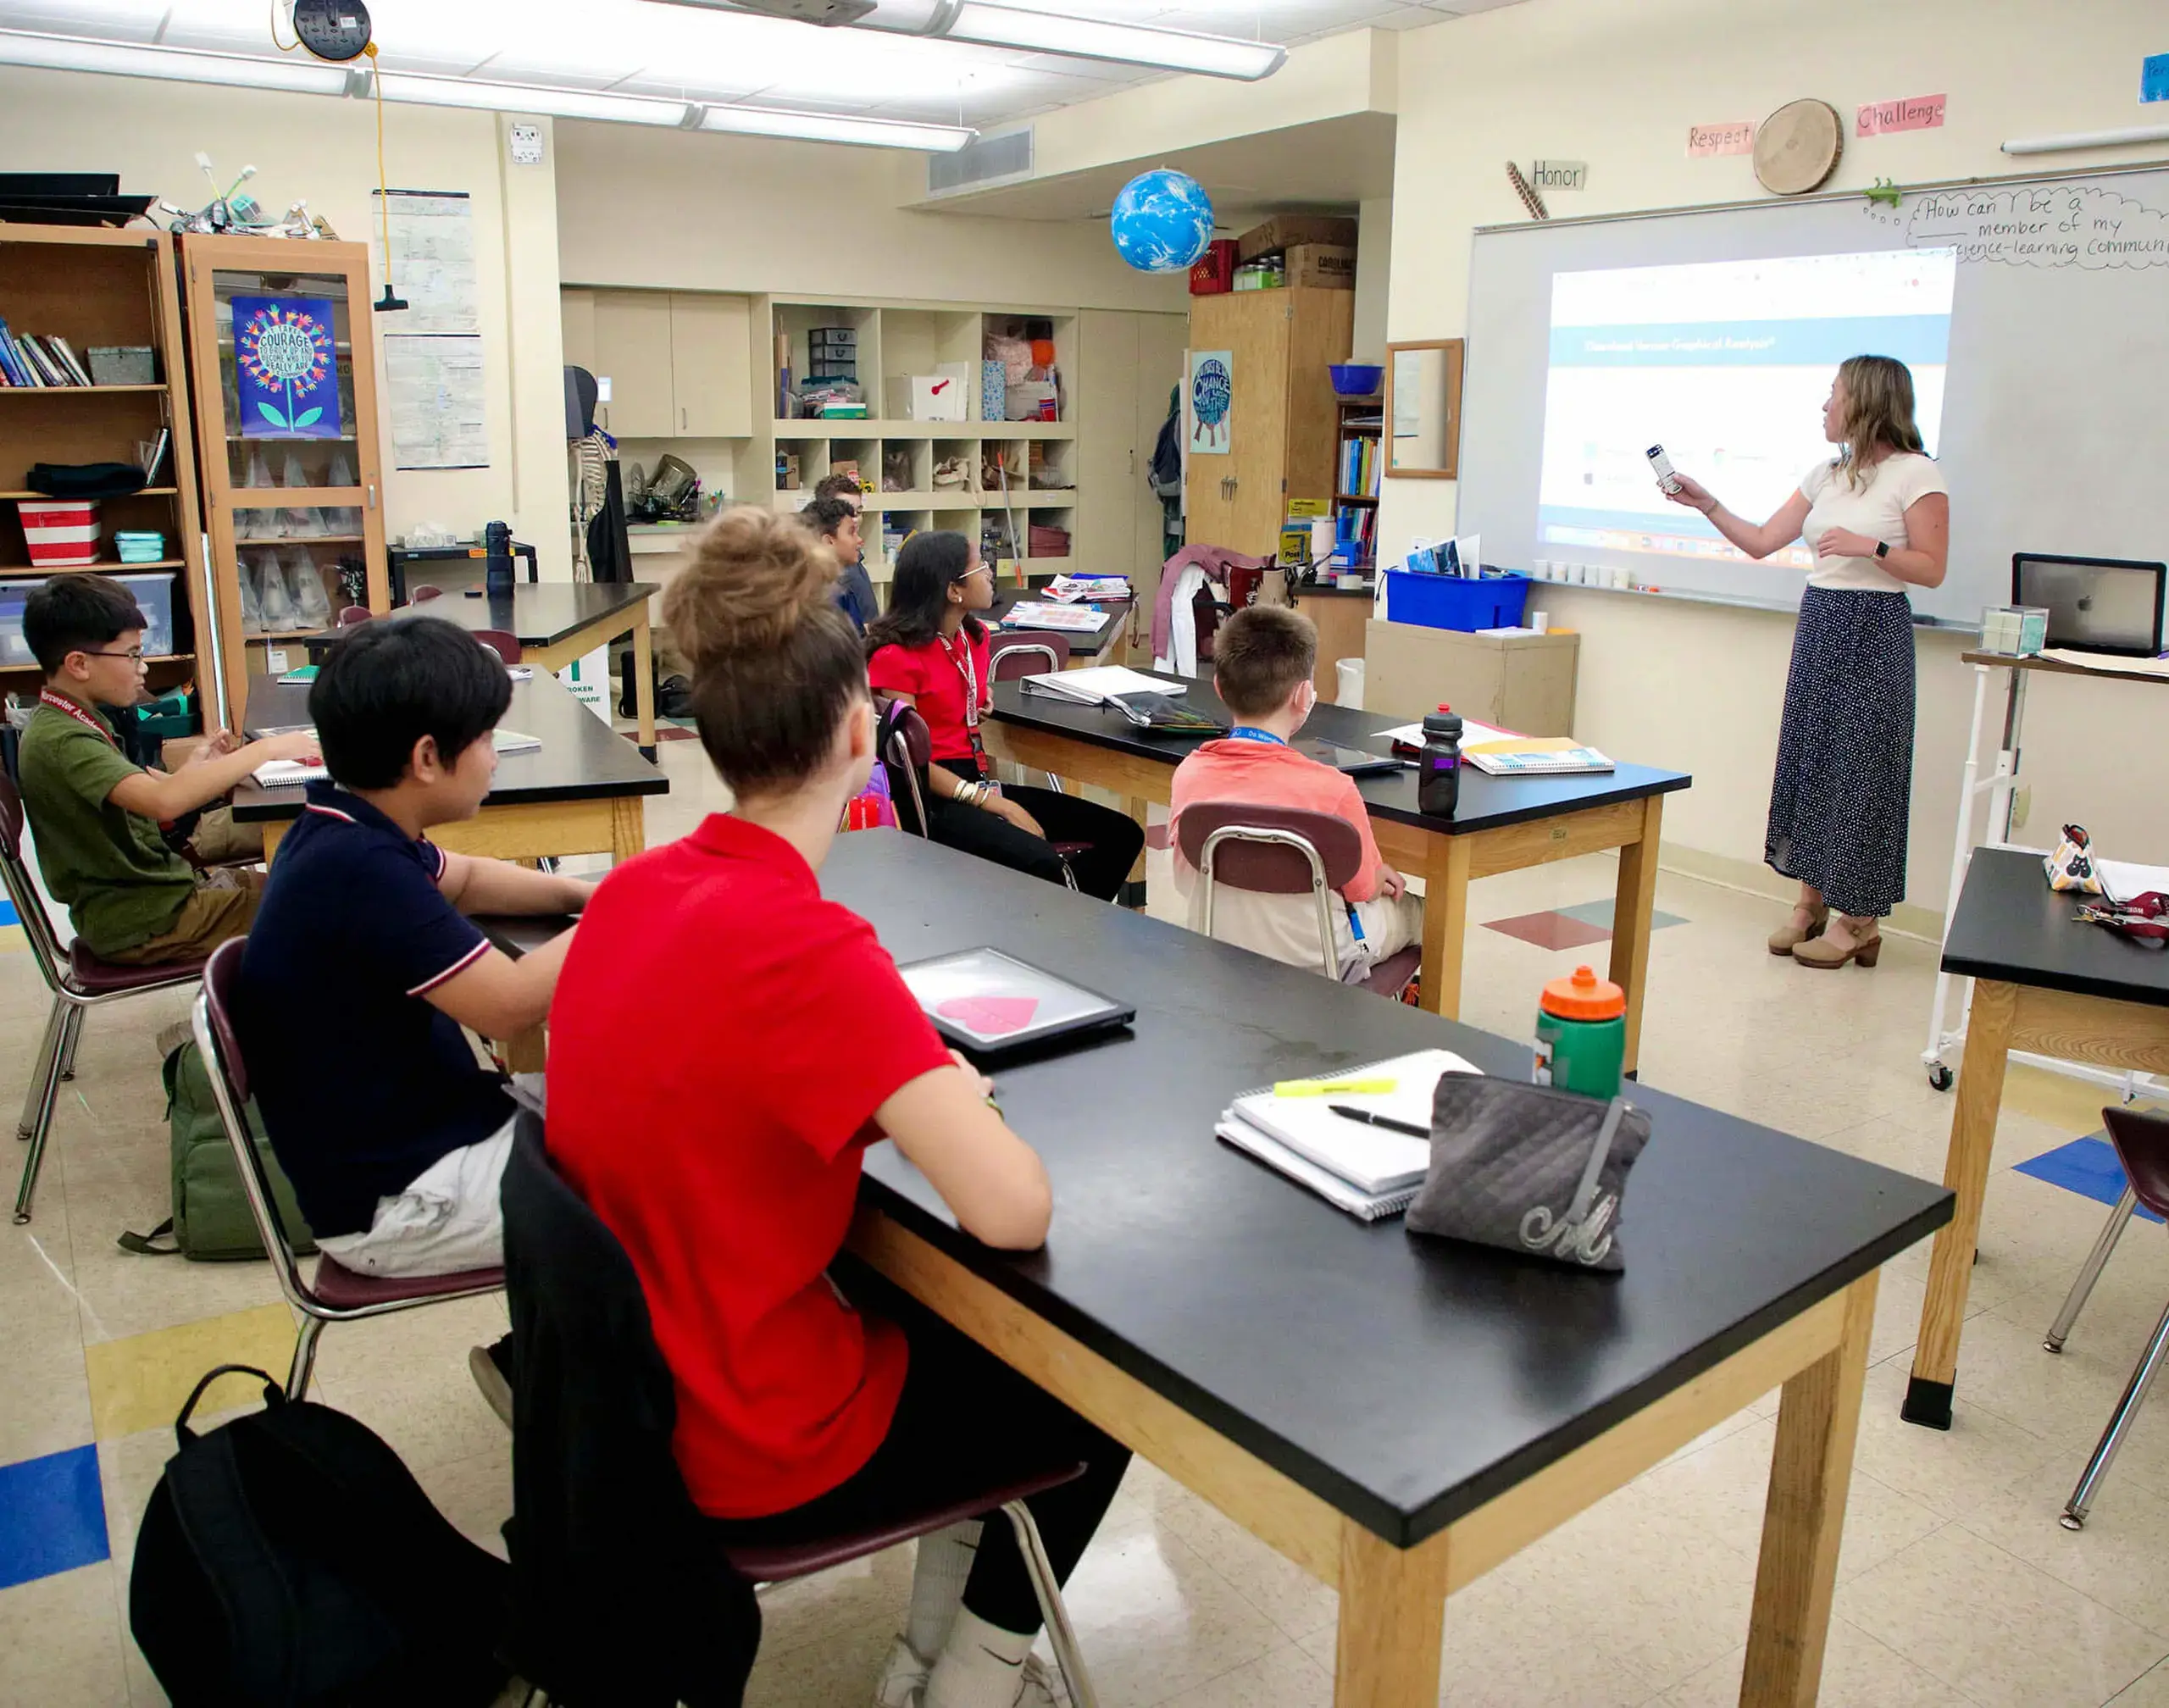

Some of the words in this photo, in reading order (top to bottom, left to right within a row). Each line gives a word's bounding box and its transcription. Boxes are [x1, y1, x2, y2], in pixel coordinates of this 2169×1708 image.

[1857, 100, 1944, 129] Challenge
[1689, 126, 1750, 152] Respect
[1534, 160, 1581, 186] Honor
[1925, 199, 1959, 219] How
[1967, 202, 1996, 216] can
[2010, 196, 2016, 213] I
[2029, 197, 2052, 213] be
[2068, 197, 2083, 211] a
[1978, 220, 2050, 237] member
[2058, 212, 2082, 232] of
[2094, 218, 2122, 238] my
[260, 332, 309, 347] COURAGE
[266, 362, 293, 373] REALLY
[1193, 375, 1230, 402] CHANGE
